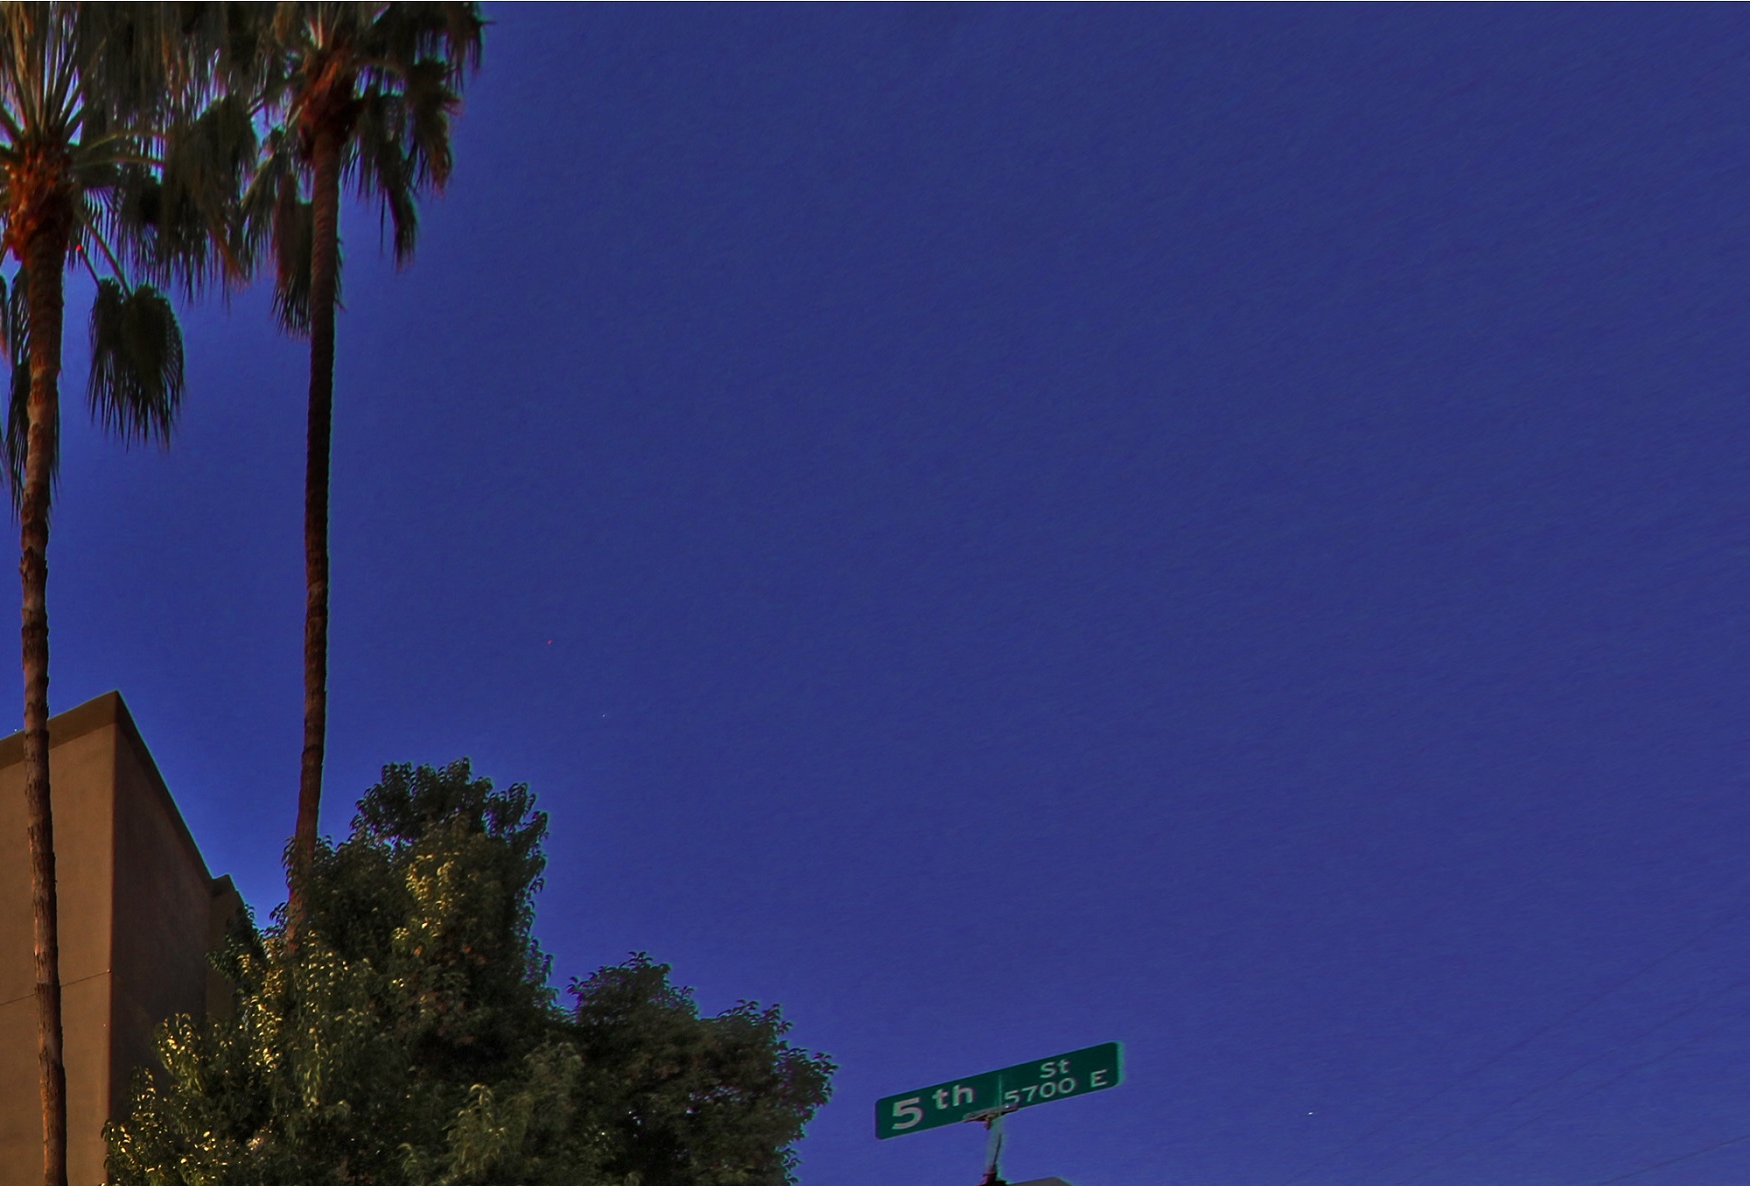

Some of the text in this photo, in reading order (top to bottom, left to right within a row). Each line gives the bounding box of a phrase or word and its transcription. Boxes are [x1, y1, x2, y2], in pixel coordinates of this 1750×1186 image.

[1039, 1058, 1070, 1079] St
[1003, 1069, 1109, 1104] 5700 E
